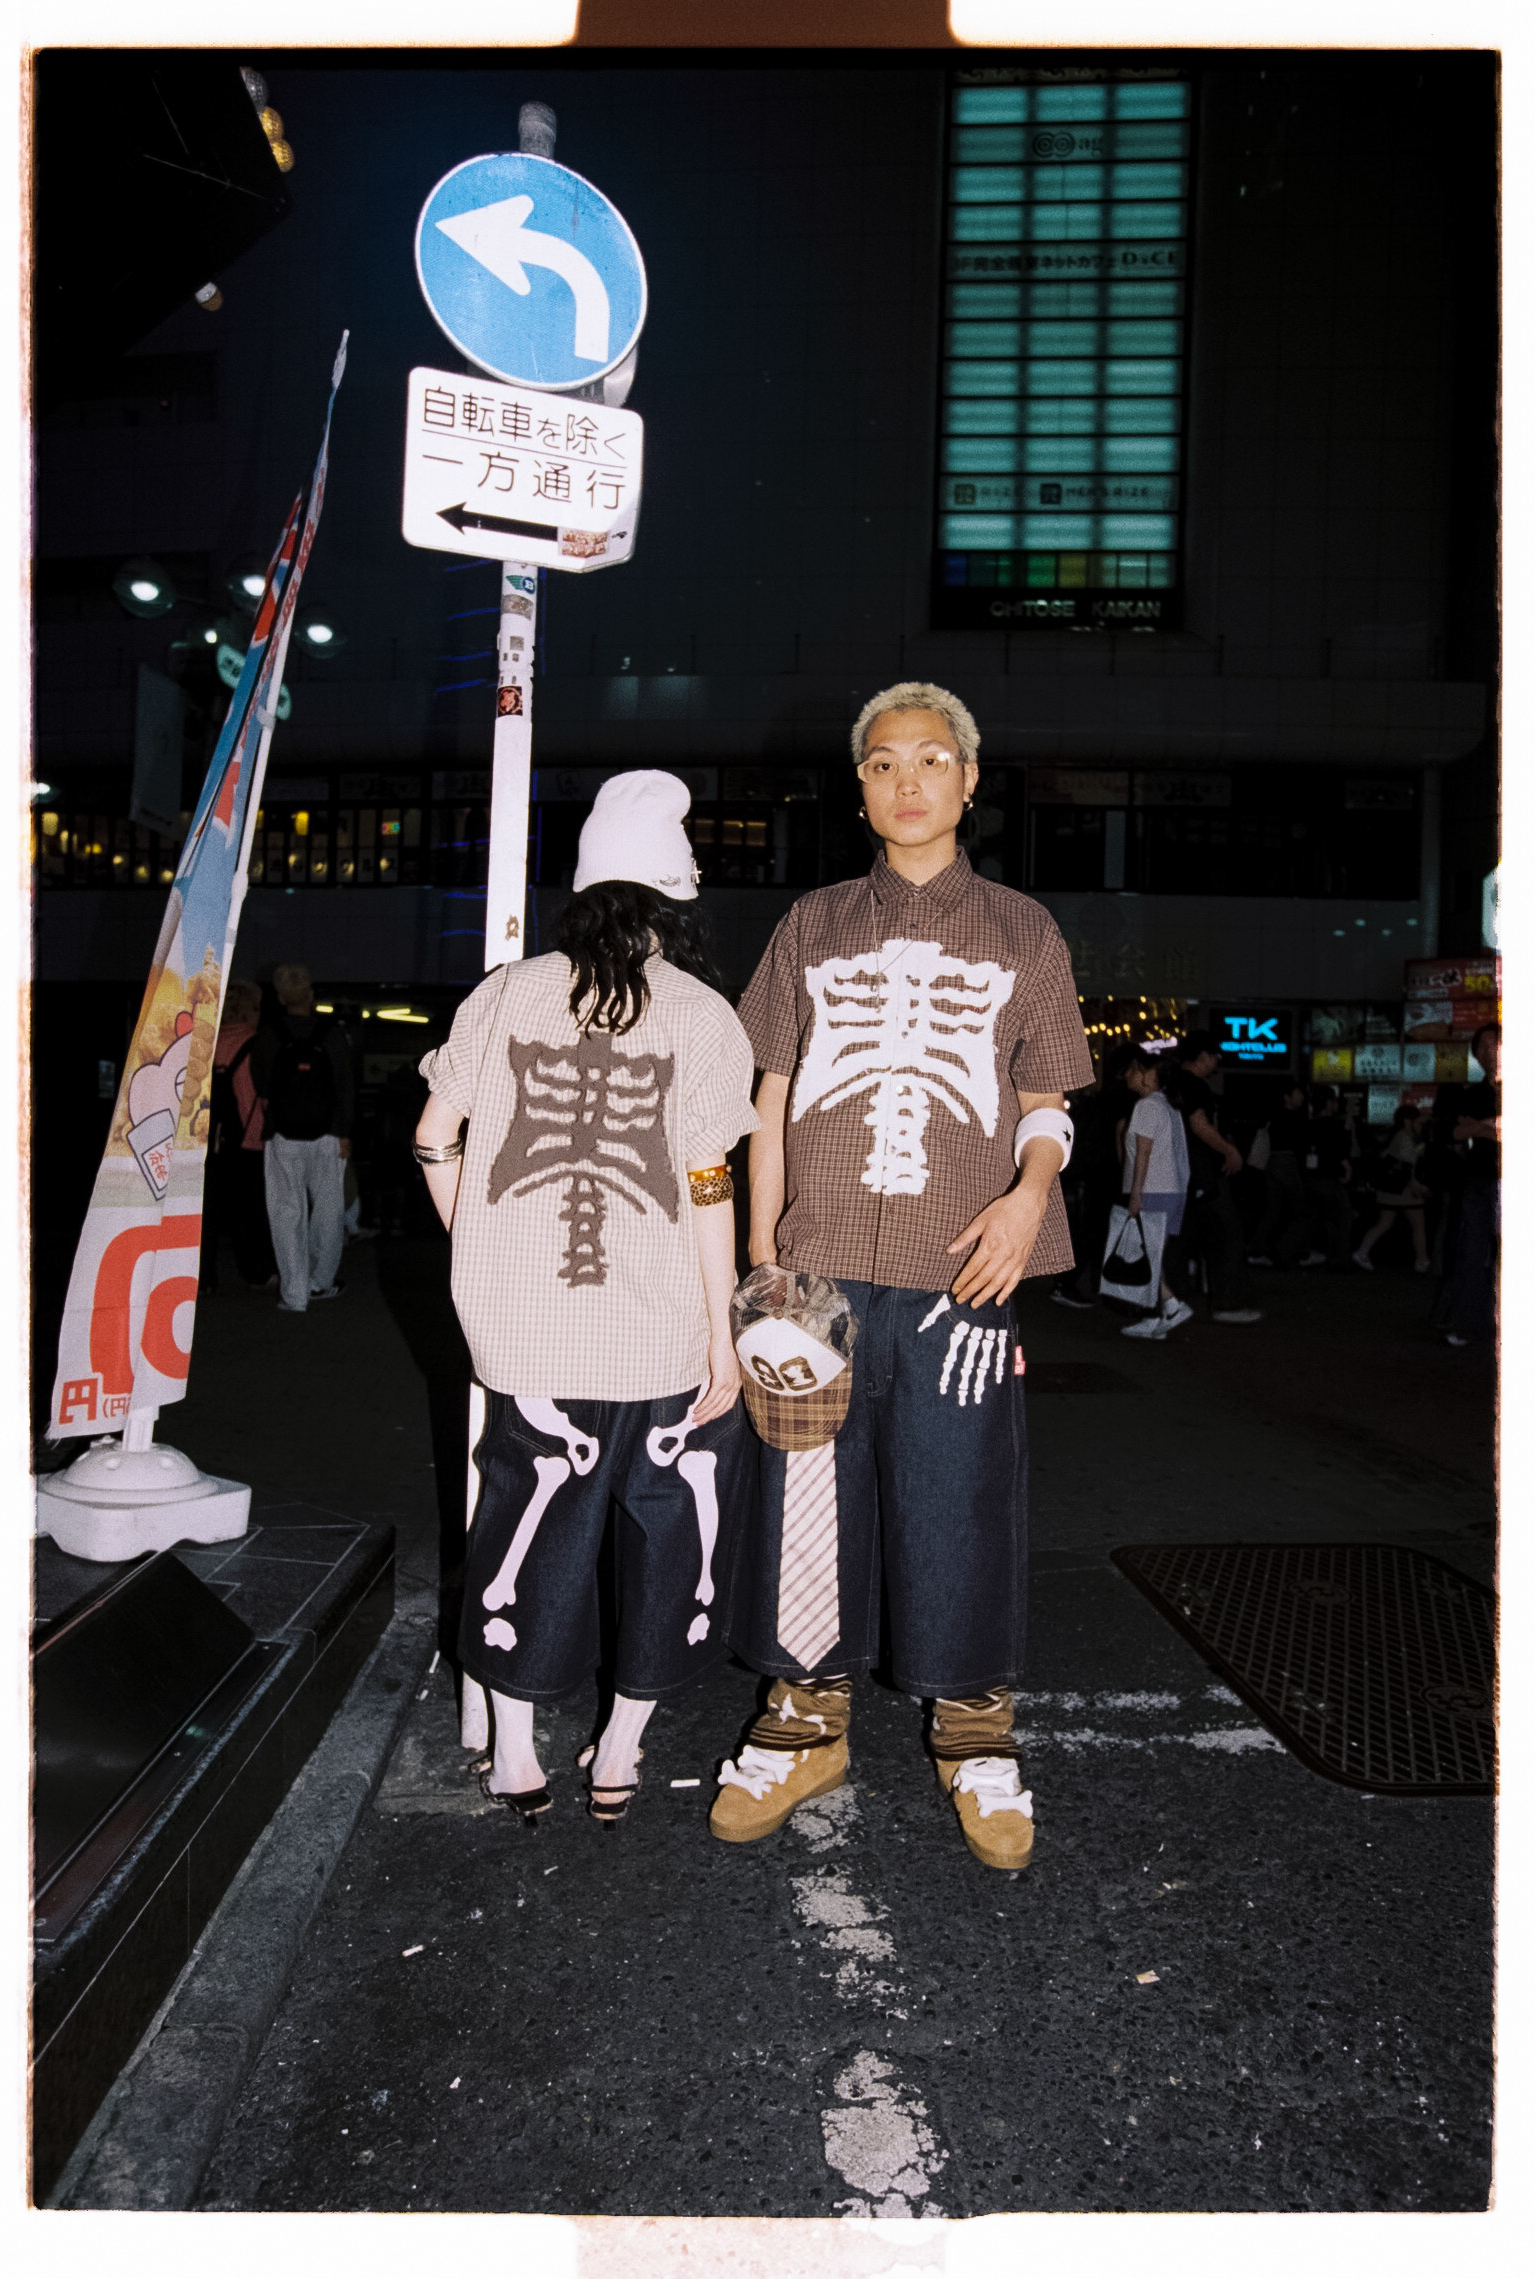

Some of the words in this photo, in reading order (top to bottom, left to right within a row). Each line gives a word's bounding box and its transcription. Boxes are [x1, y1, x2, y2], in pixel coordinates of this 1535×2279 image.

[423, 385, 627, 461] 自転車を除く
[422, 450, 627, 510] 一方通行
[989, 599, 1077, 618] CHITOSE
[1090, 599, 1162, 618] KAIKAN
[1224, 1017, 1278, 1040] TK
